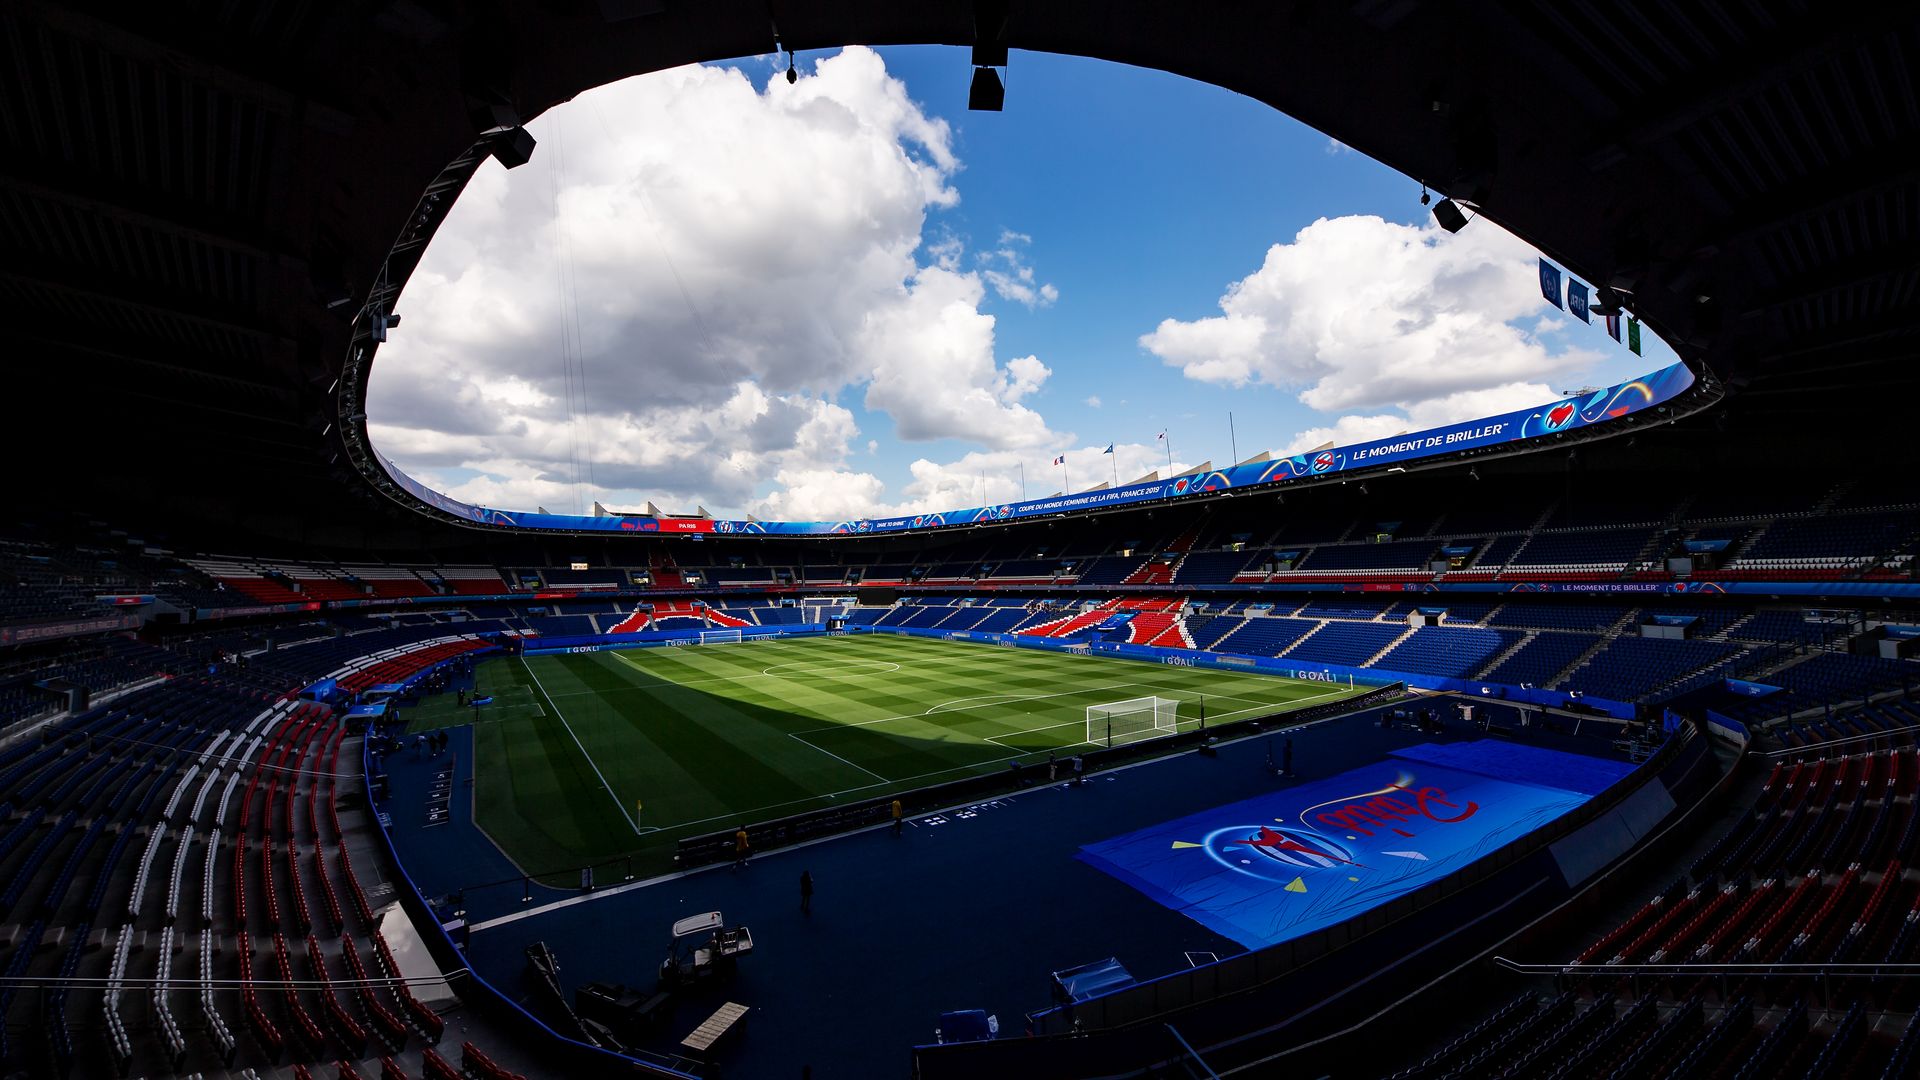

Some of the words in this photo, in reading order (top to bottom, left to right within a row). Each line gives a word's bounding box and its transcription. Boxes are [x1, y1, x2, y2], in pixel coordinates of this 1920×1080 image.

[1353, 449, 1367, 461] LE
[1369, 439, 1424, 457] MOMENT
[1425, 435, 1443, 448] DE
[1018, 504, 1035, 512] COUPE
[1043, 500, 1063, 509] MONDE
[1089, 495, 1098, 503] DE
[1097, 494, 1106, 502] LA
[1120, 488, 1145, 499] FRANCE
